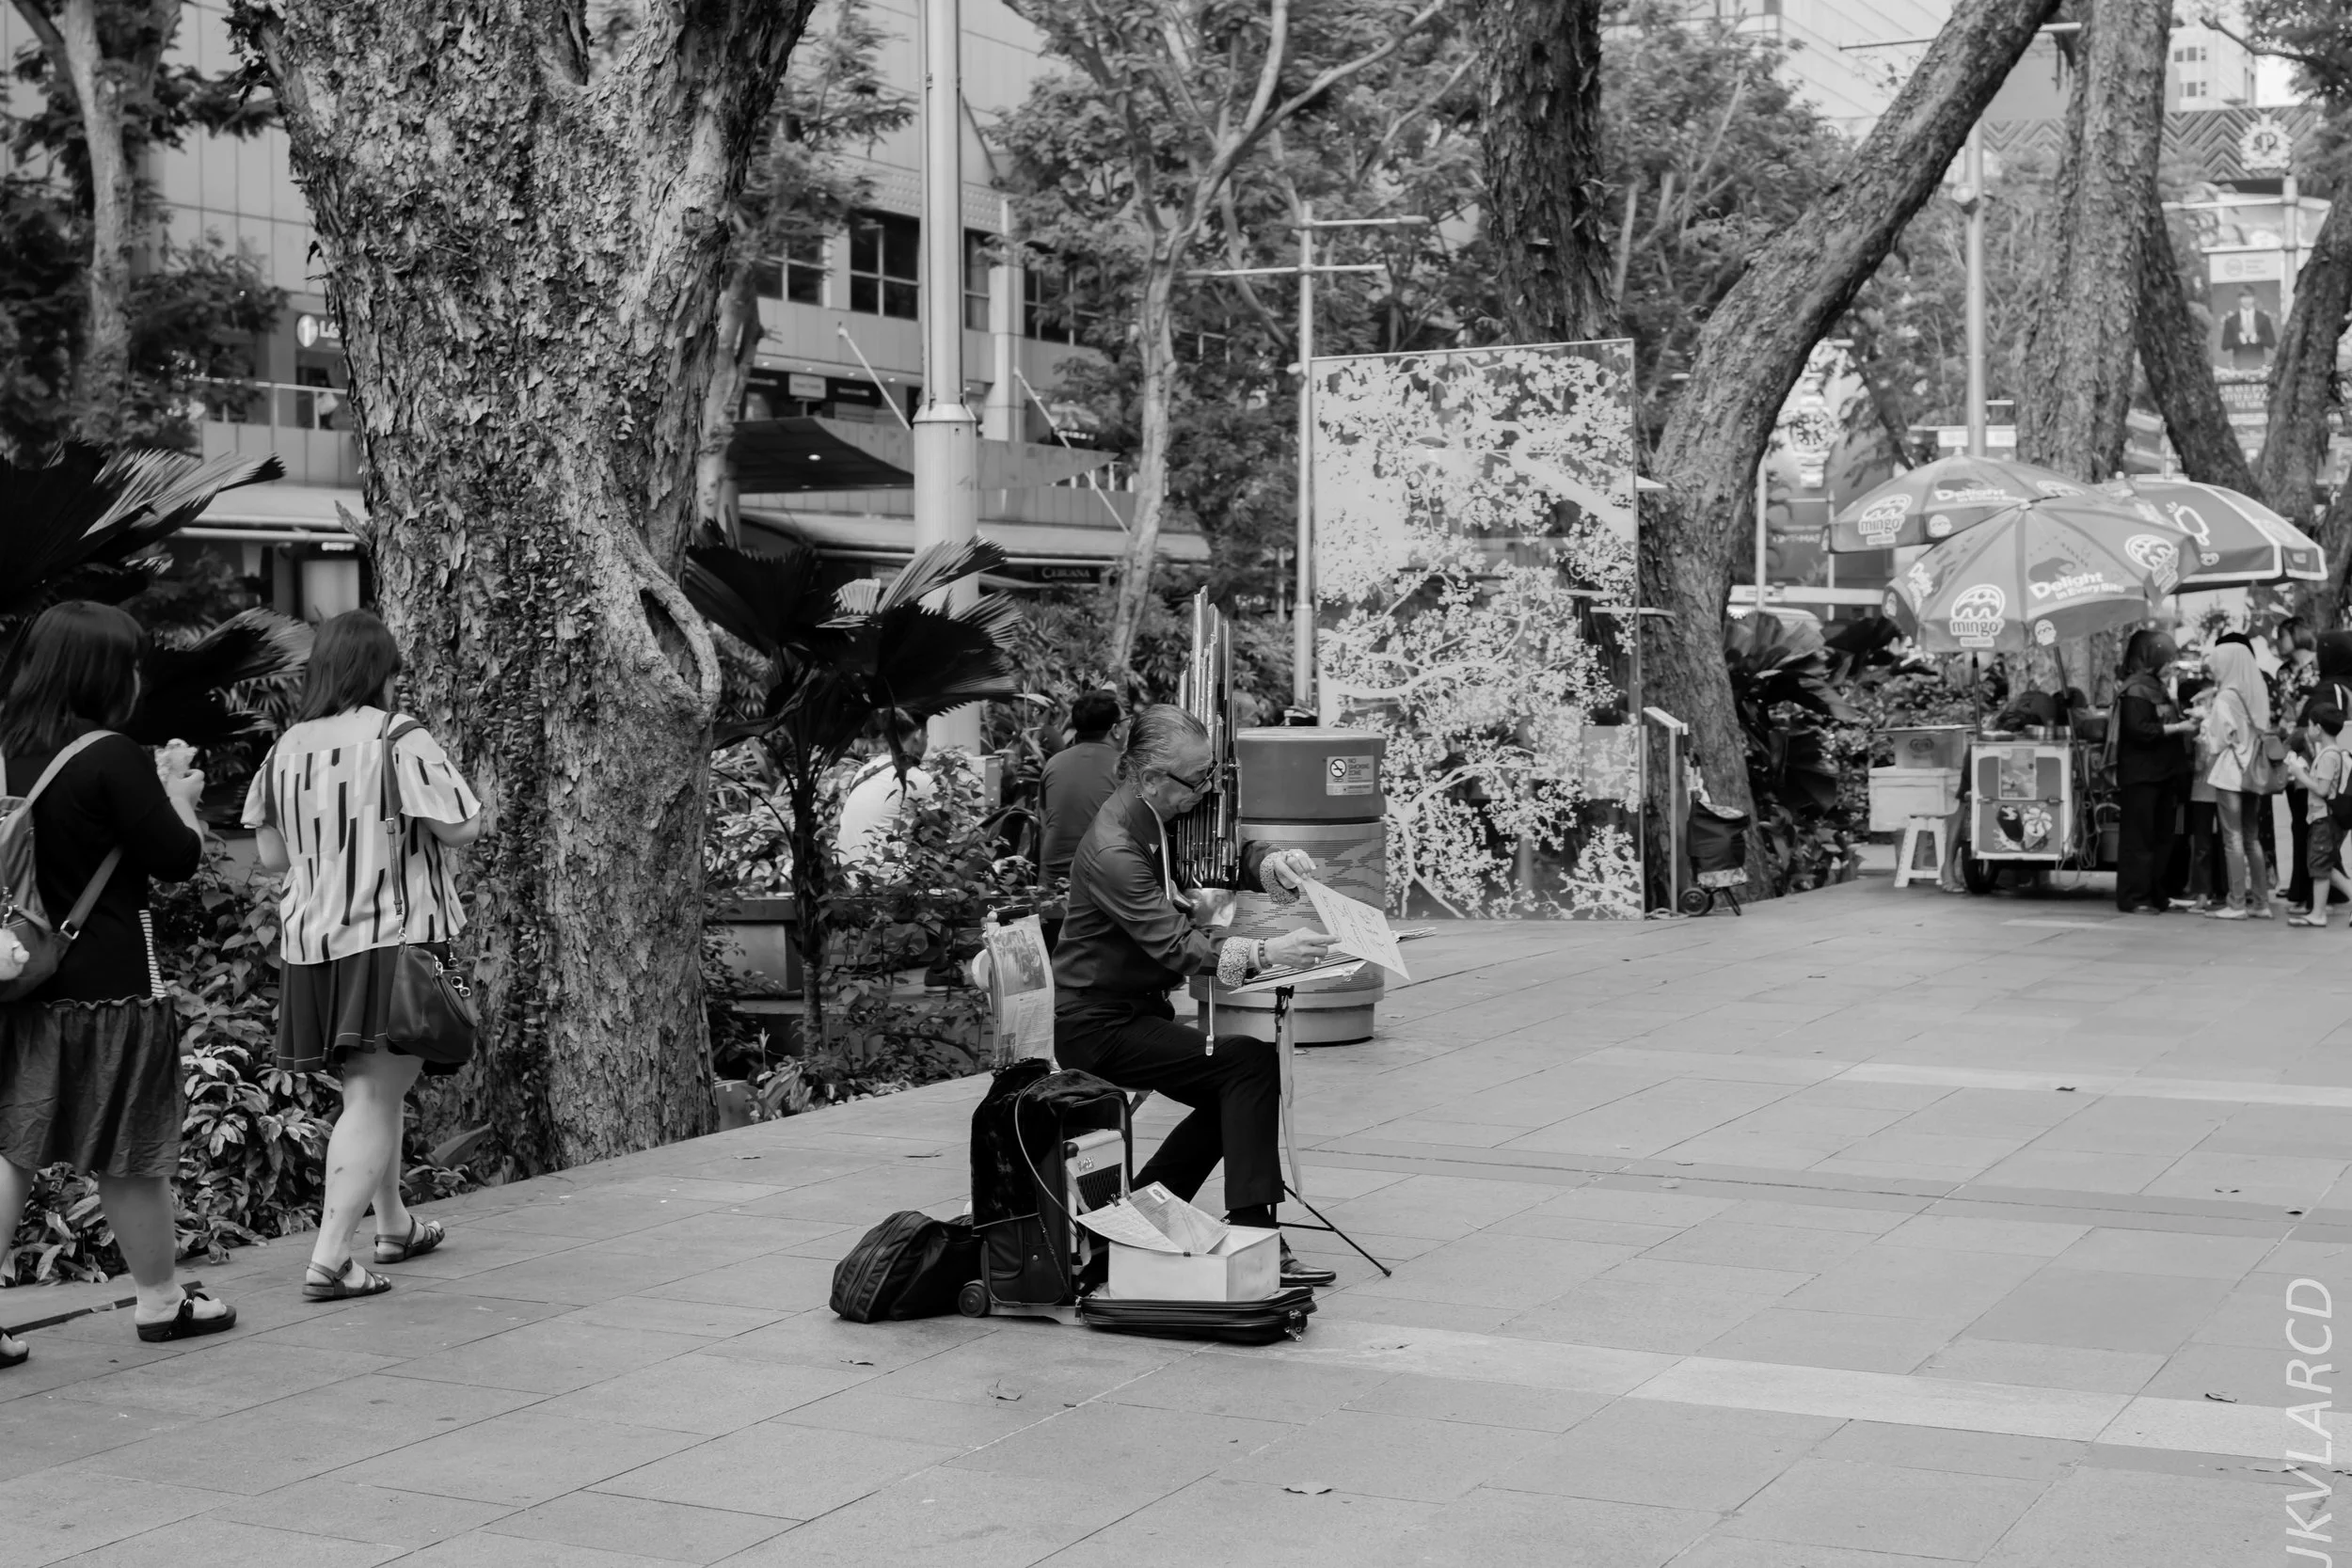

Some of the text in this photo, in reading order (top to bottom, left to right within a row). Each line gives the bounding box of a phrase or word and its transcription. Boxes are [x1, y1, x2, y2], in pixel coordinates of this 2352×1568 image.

[1860, 517, 1901, 534] mingo
[2028, 571, 2105, 600] Delight
[1951, 620, 2000, 638] mingo
